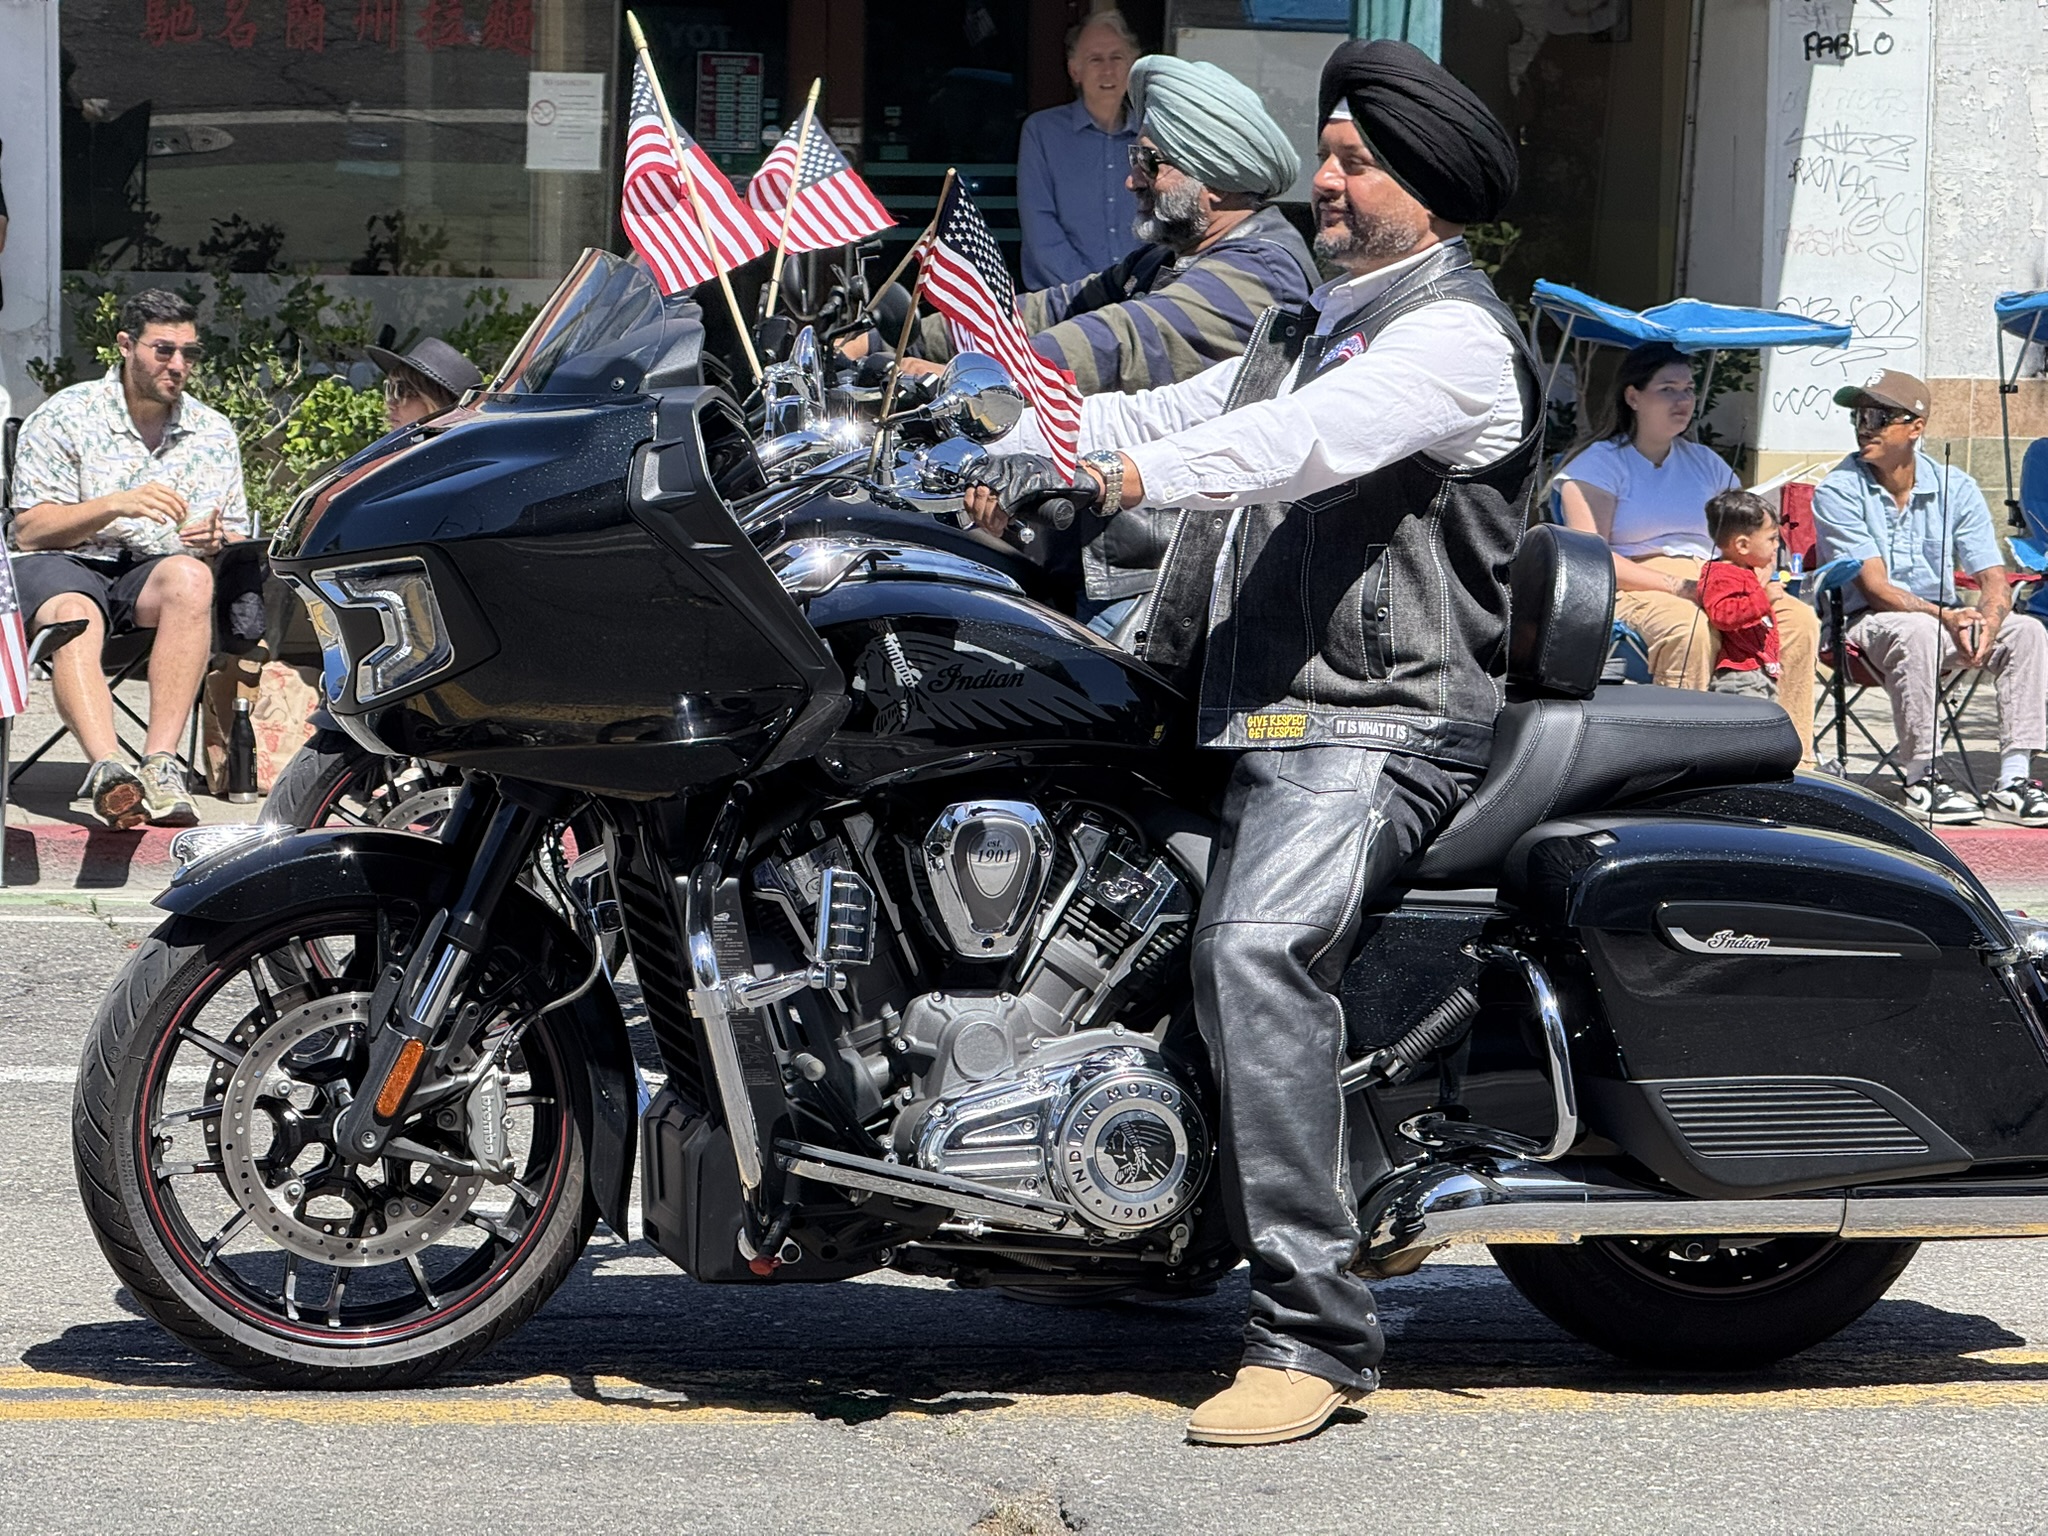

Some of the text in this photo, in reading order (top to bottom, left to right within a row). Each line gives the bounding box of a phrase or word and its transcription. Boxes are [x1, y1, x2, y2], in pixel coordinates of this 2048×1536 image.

[1803, 31, 1894, 61] PABLO
[927, 663, 1025, 693] Indian
[1247, 714, 1308, 728] GIVE RESPECT
[1336, 720, 1408, 740] IT IS WHAT IT IS
[1248, 726, 1306, 739] GET RESPECT
[987, 839, 1002, 848] est.
[977, 849, 1011, 863] 1901
[1706, 929, 1770, 949] Indian
[481, 1094, 495, 1154] brembo
[1069, 1083, 1204, 1195] INDIAN MOTORCYCLE
[1110, 1203, 1160, 1219] 1901
